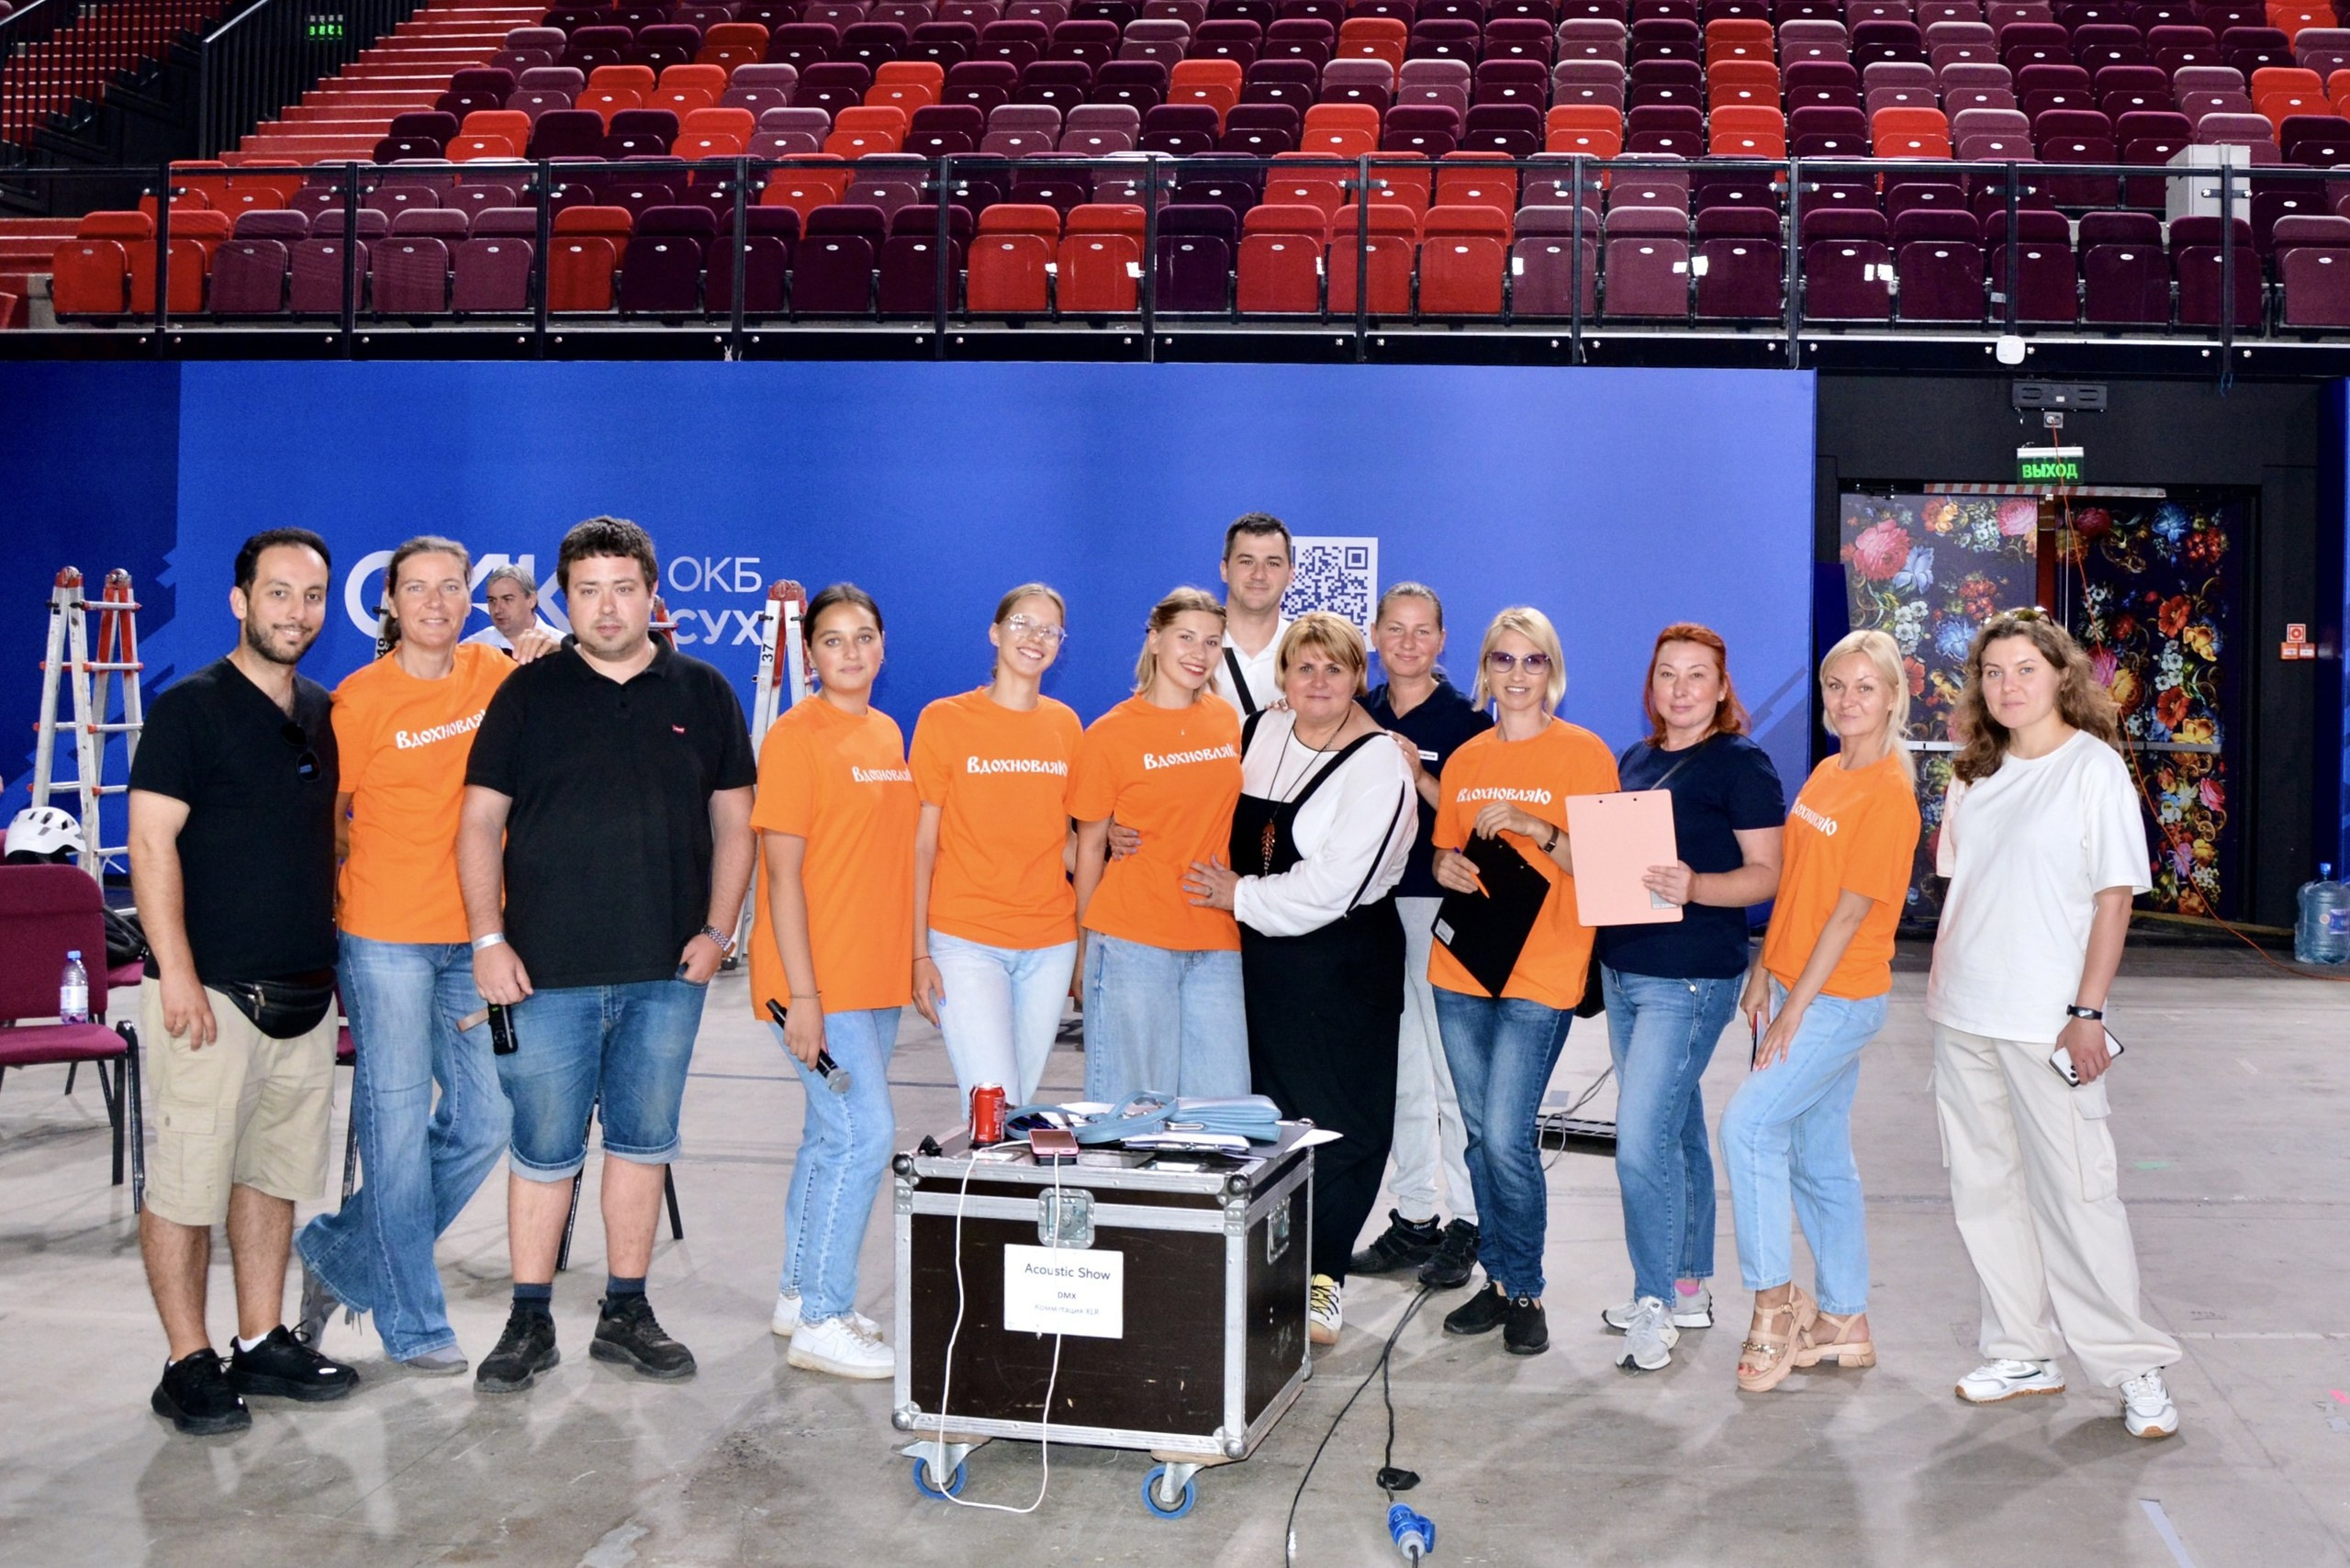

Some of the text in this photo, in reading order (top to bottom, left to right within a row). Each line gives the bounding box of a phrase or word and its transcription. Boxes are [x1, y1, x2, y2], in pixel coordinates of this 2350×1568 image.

[2022, 464, 2078, 479] ВЫХОД
[668, 556, 762, 592] ОКБ
[762, 644, 774, 662] 37
[1024, 1262, 1111, 1281] Acoustic Show
[1057, 1292, 1077, 1300] DMX
